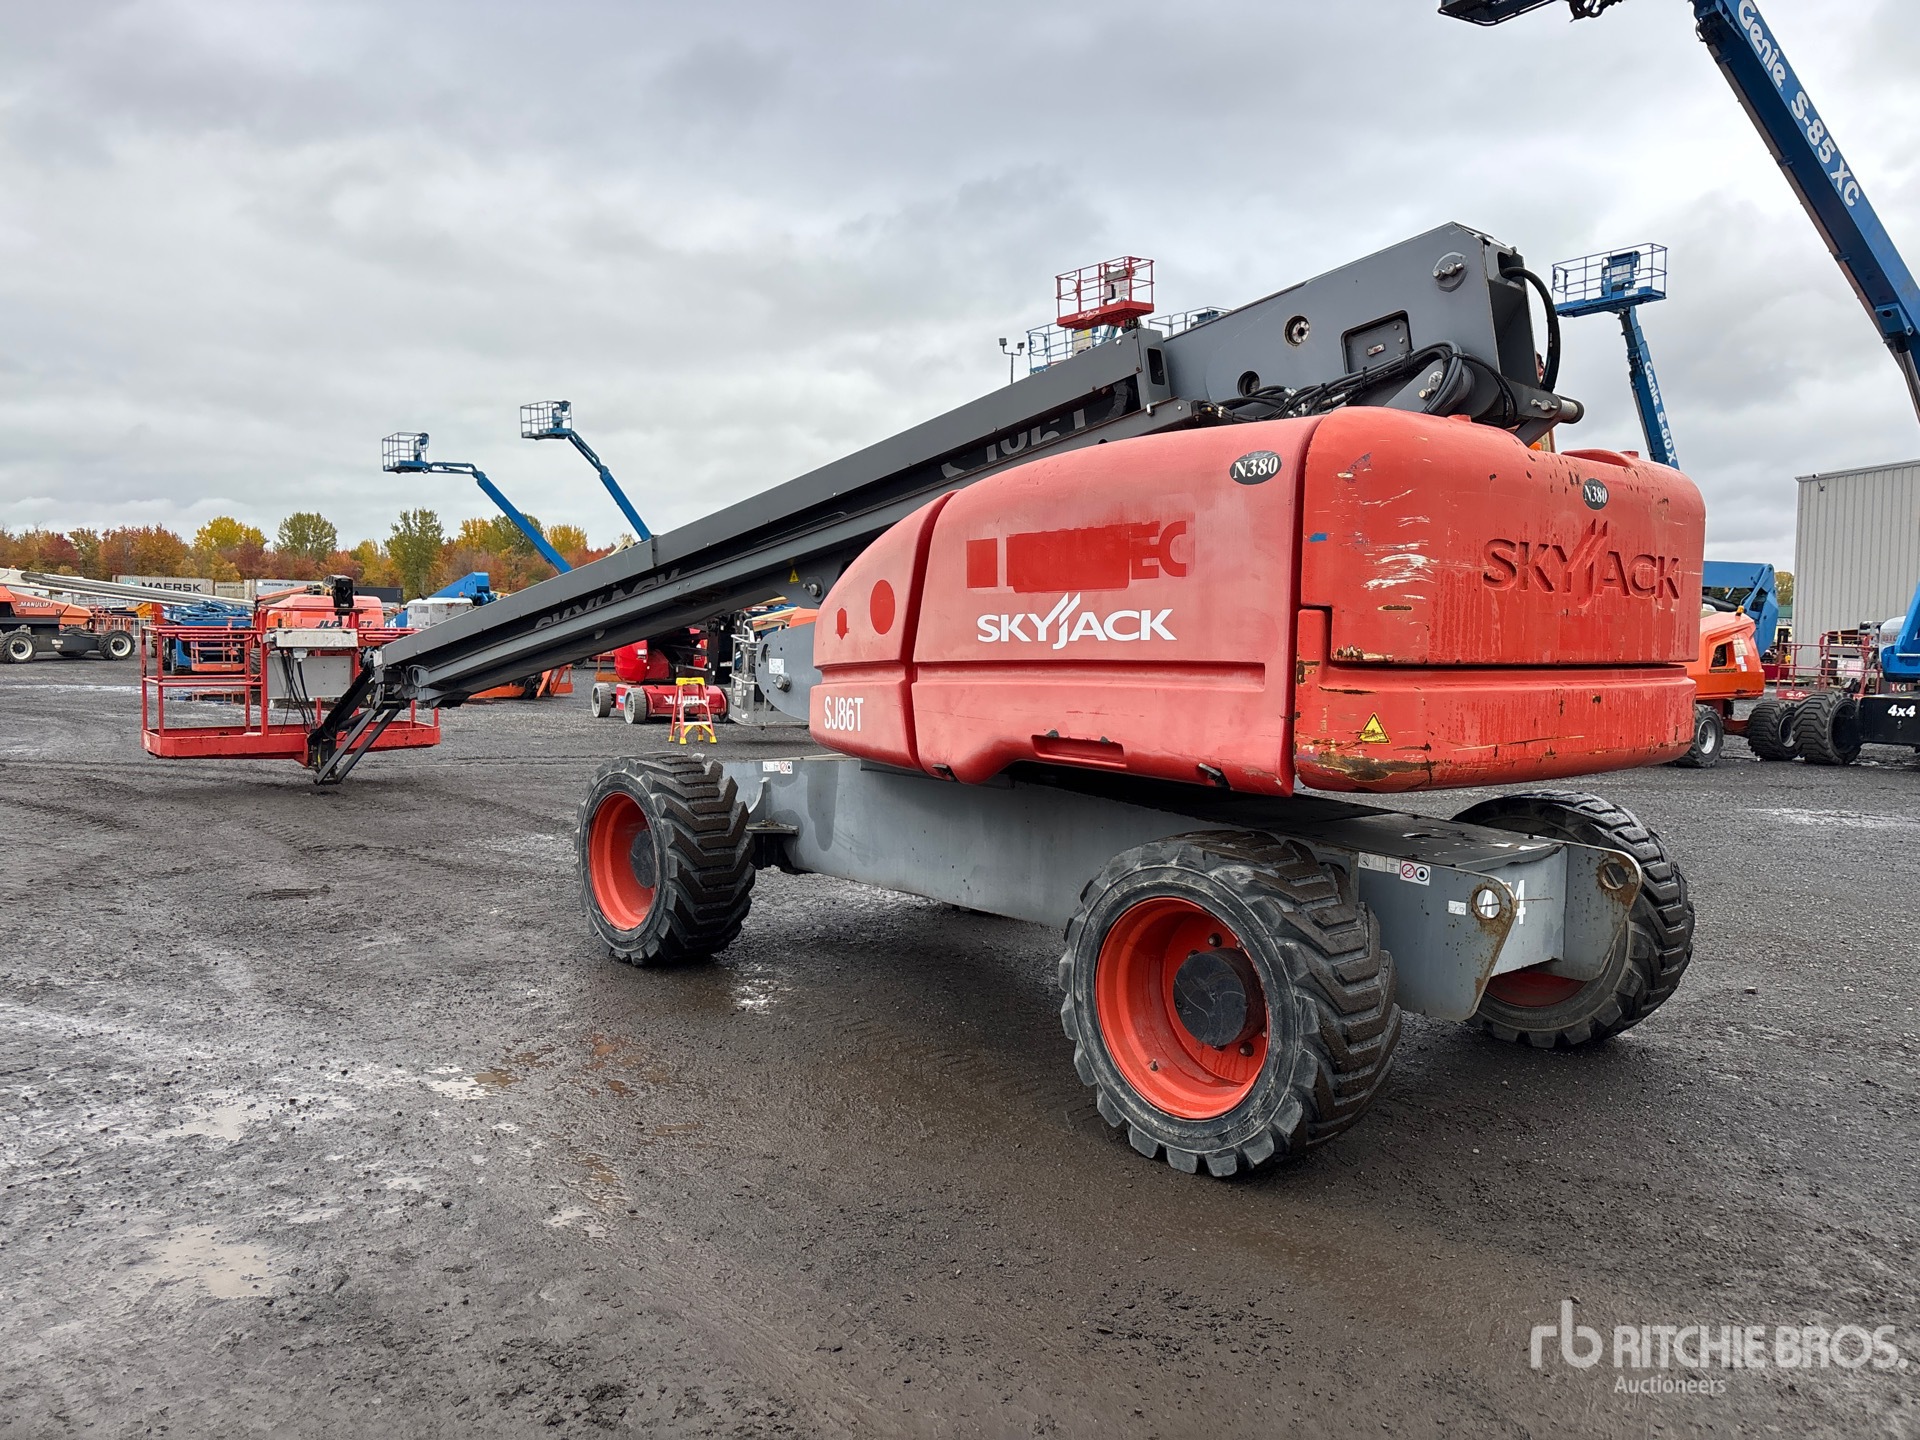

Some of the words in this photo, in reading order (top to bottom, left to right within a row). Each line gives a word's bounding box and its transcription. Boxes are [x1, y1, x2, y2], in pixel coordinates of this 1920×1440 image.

[1738, 0, 1786, 86] Genie
[1791, 91, 1836, 164] S-85
[1830, 159, 1860, 207] XC
[1644, 360, 1660, 406] Genie
[1657, 411, 1673, 449] S-60
[1233, 454, 1280, 479] N380
[1583, 485, 1607, 504] N380
[1483, 518, 1681, 608] SKYJACK
[141, 582, 202, 592] MAERSK
[976, 592, 1177, 649] SKYJACK
[824, 695, 864, 732] SJ86T
[1887, 704, 1916, 718] 4x4
